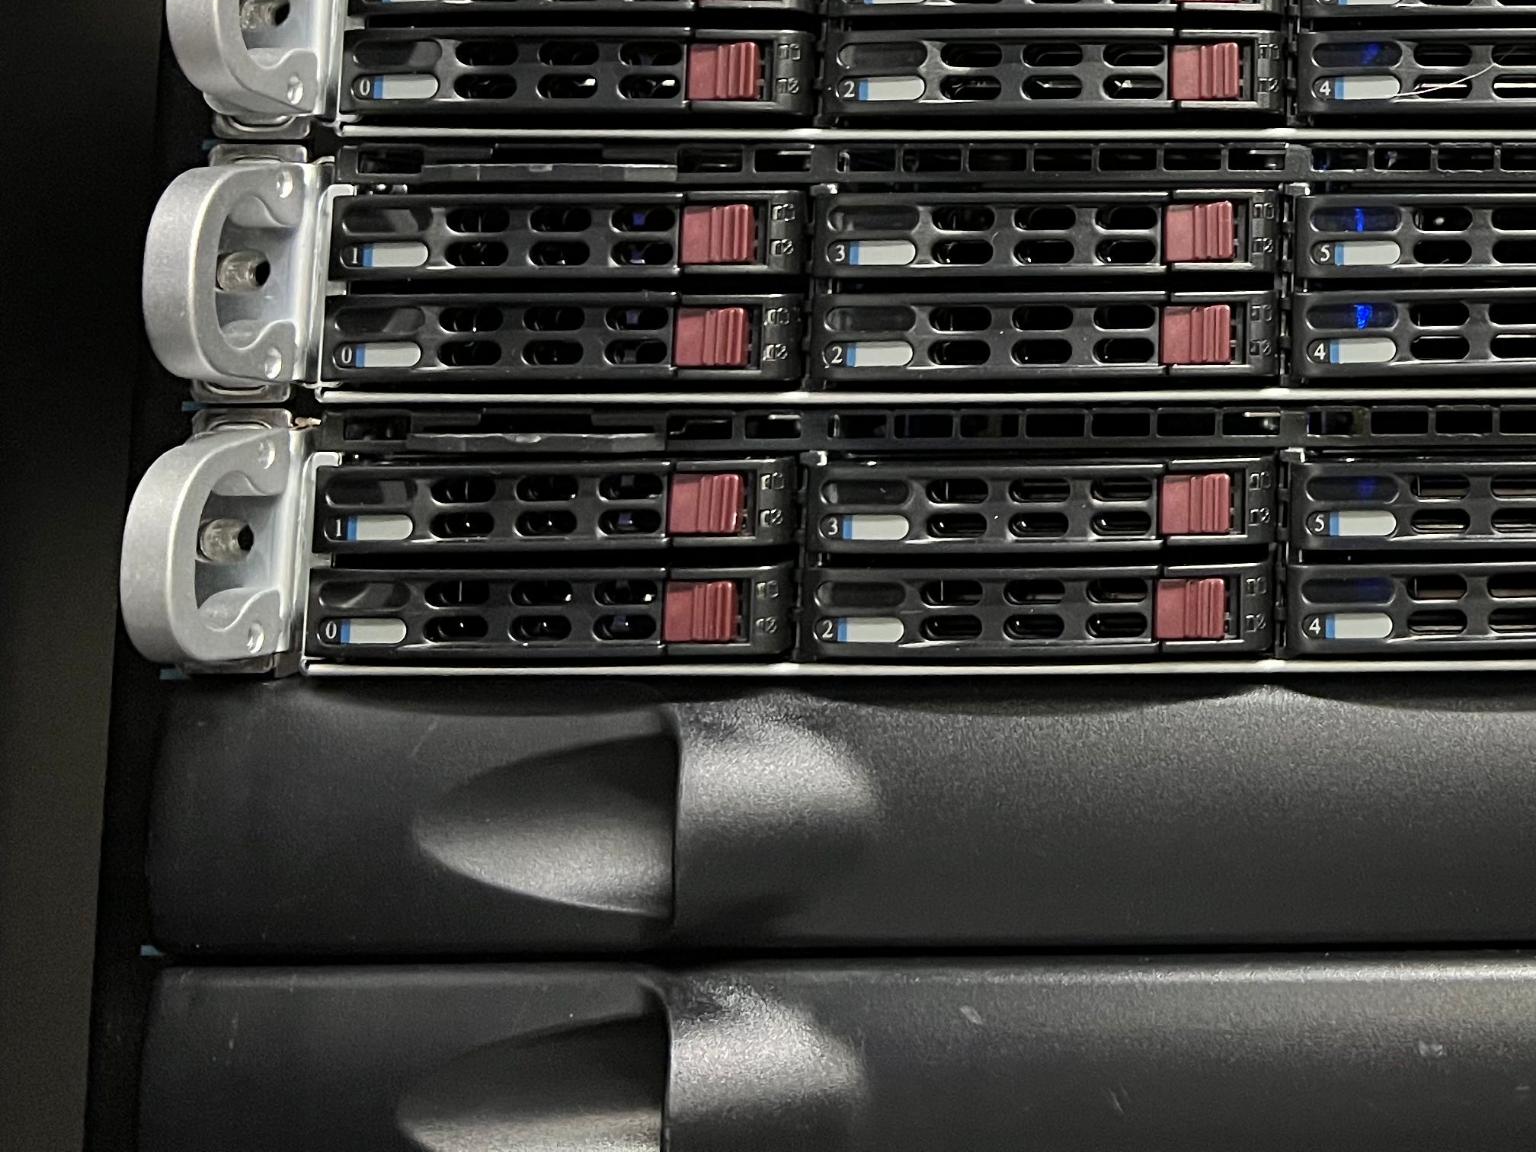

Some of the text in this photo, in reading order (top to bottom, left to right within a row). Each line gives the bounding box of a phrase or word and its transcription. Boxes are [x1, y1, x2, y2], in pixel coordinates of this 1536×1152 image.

[359, 78, 371, 97] 0
[842, 79, 856, 99] 2
[1318, 79, 1332, 97] 4
[351, 247, 359, 265] 1
[834, 243, 846, 263] 3
[1319, 243, 1331, 263] 5
[340, 346, 353, 365] 0
[830, 345, 844, 365] 2
[1313, 342, 1327, 361] 4
[334, 518, 342, 538] 1
[827, 516, 839, 536] 3
[1313, 513, 1326, 533] 5
[324, 619, 338, 640] 0
[821, 618, 834, 639] 2
[1308, 616, 1322, 636] 4
